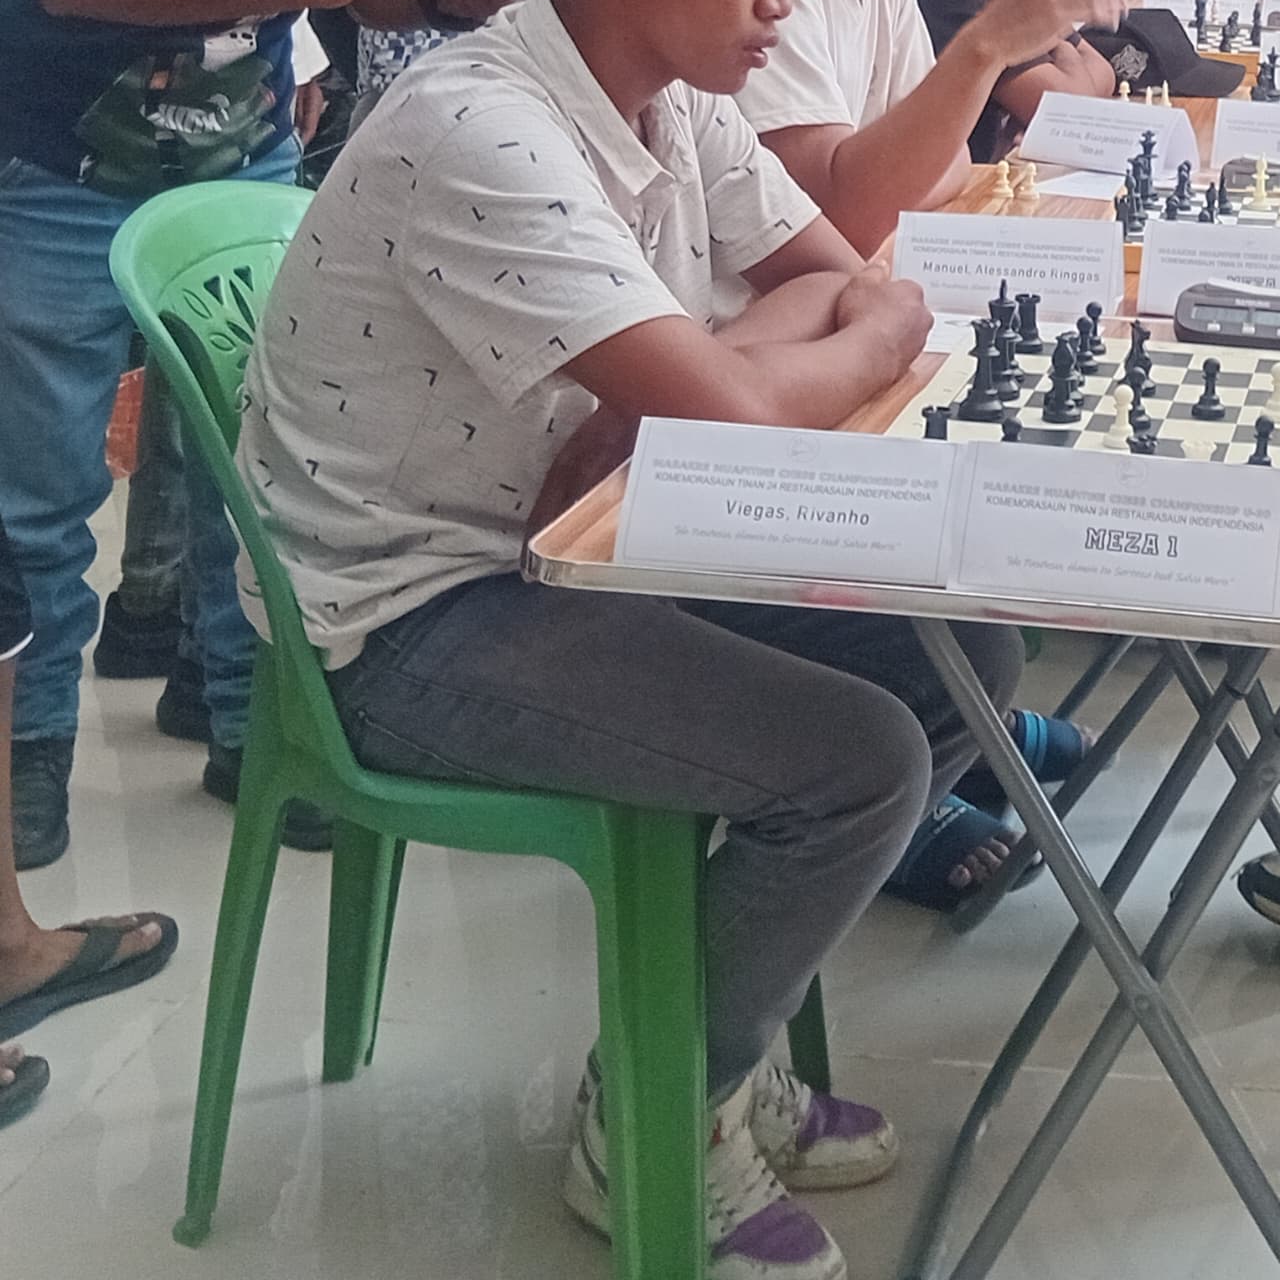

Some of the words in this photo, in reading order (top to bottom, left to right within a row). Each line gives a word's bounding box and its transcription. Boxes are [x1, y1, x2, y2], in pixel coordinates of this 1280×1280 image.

[975, 263, 1046, 279] Alessandro
[726, 498, 790, 522] Viegas,
[796, 504, 870, 526] Rivanho
[1084, 526, 1160, 557] MEZA
[1167, 534, 1179, 558] 1
